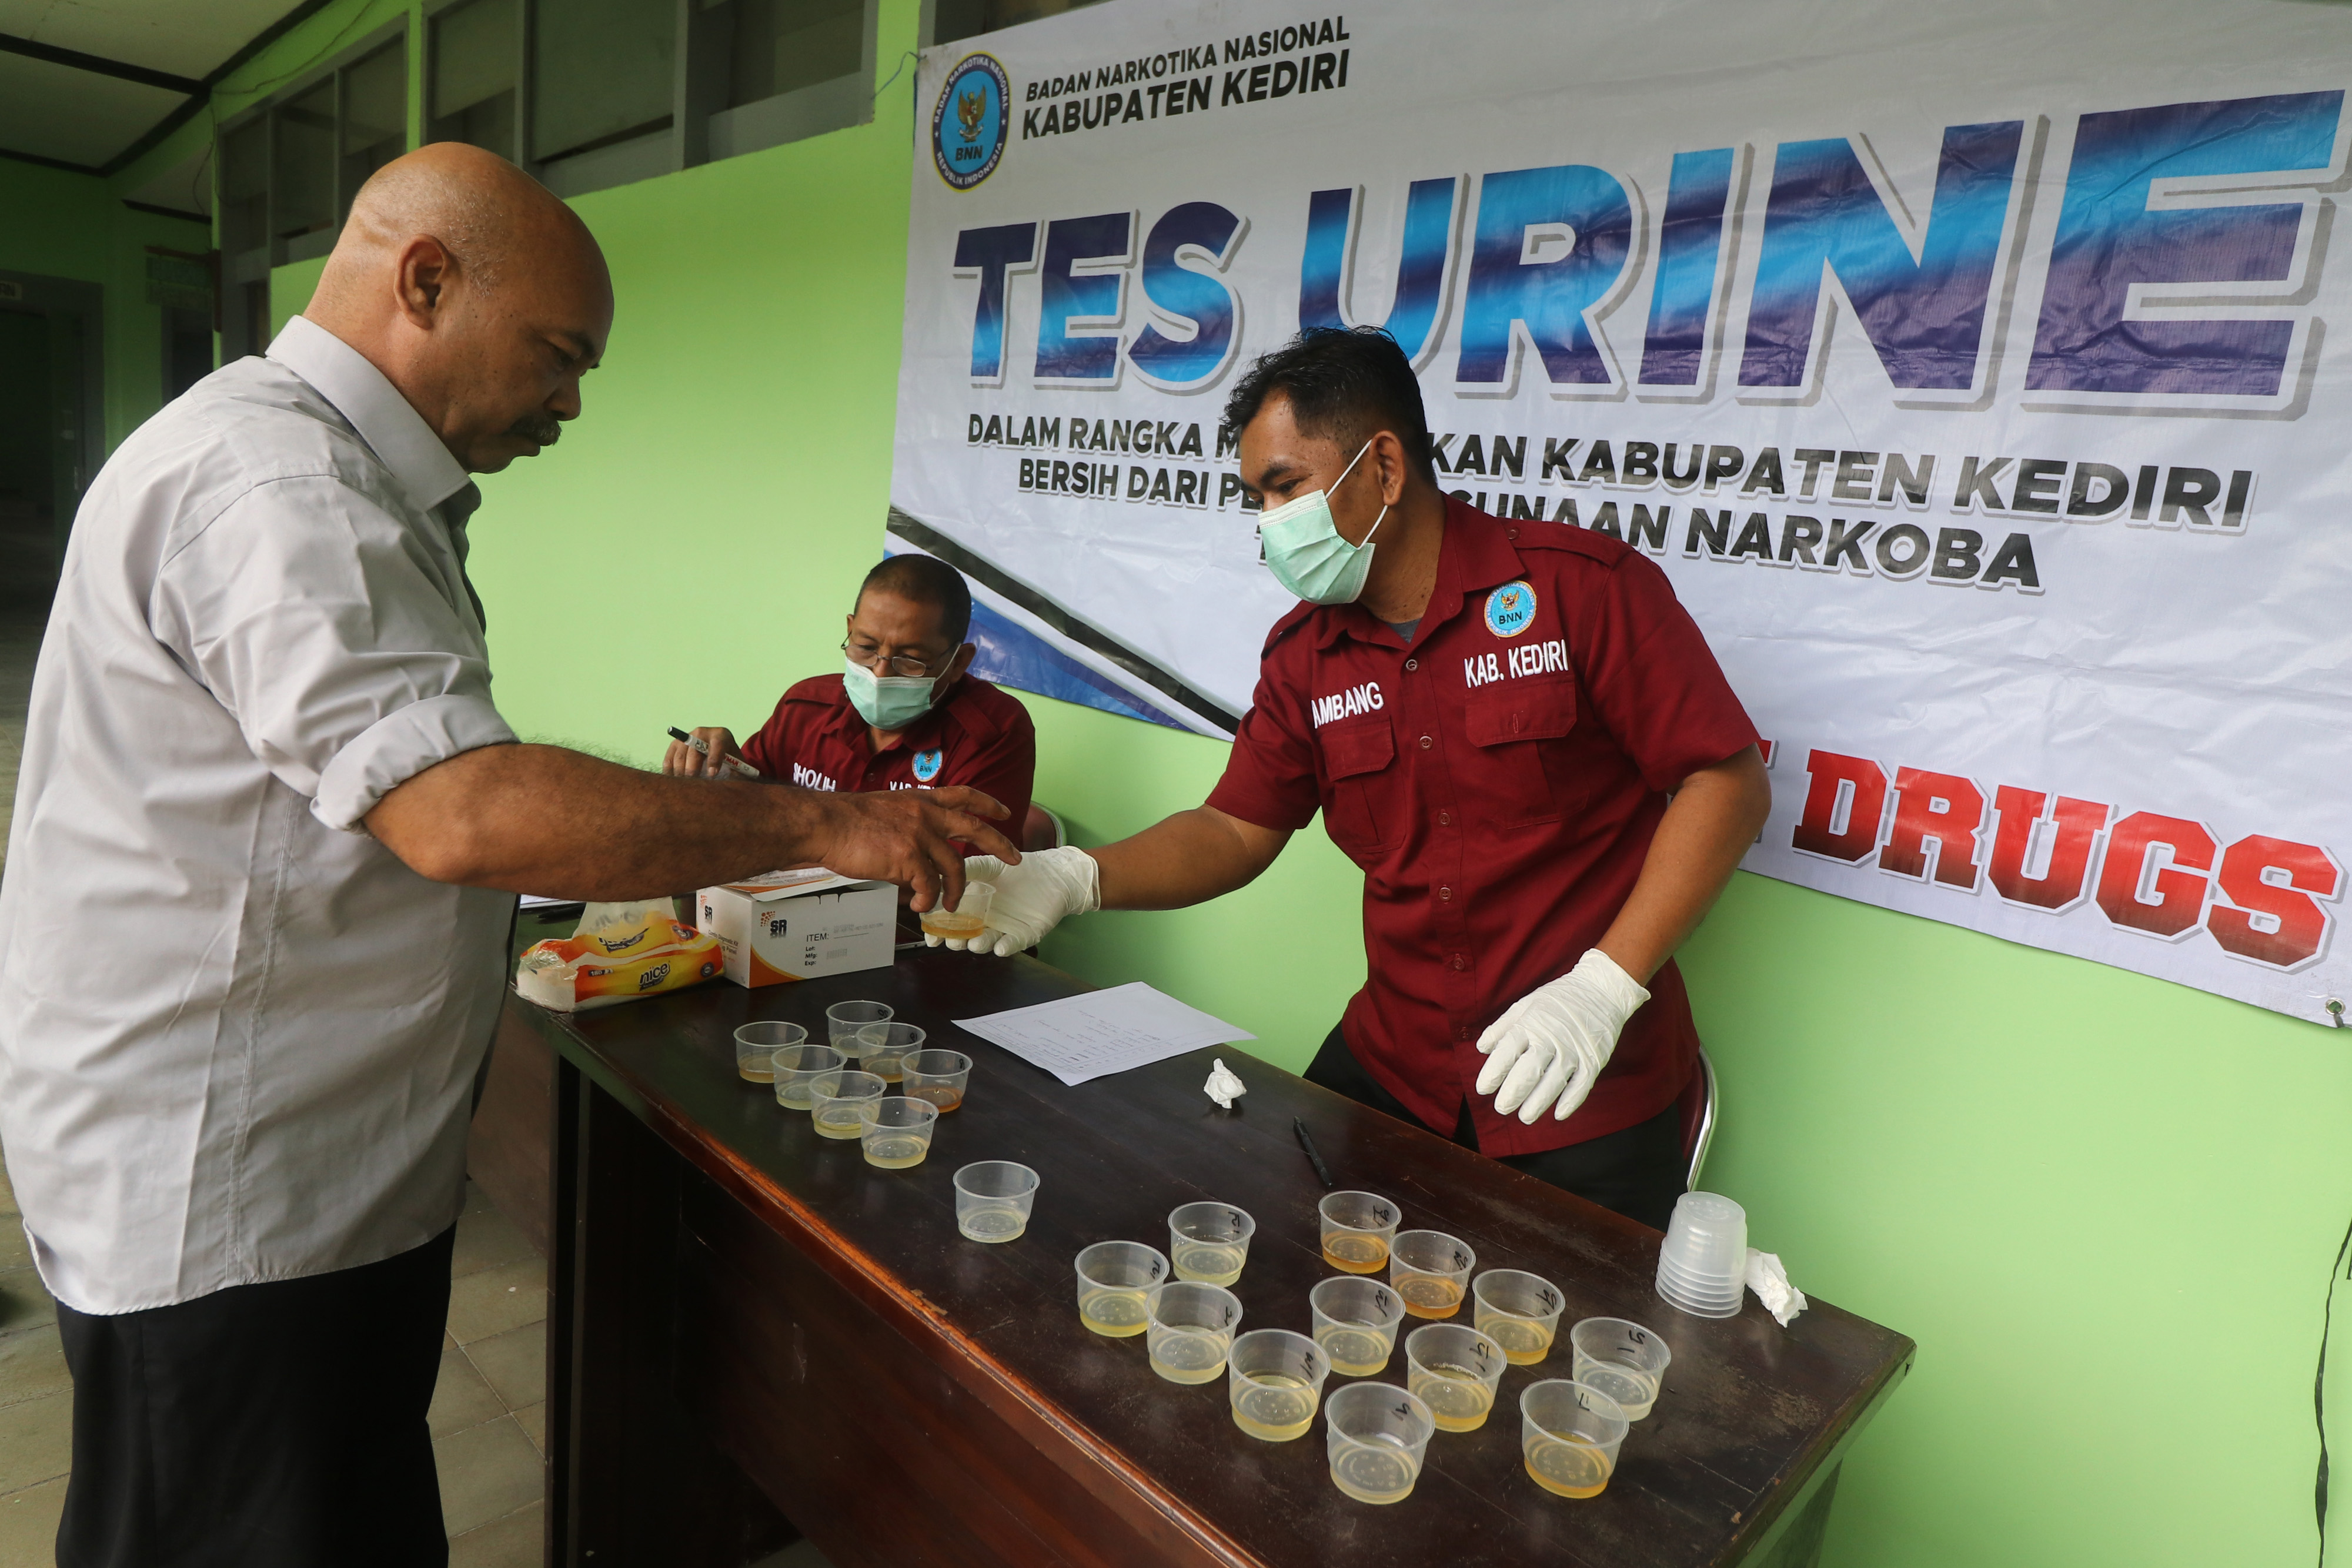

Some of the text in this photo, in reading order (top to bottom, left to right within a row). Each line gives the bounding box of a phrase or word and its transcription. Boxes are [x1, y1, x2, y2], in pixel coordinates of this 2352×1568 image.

[1026, 16, 1350, 102] BADAN NARKOTIKA NASIONAL
[934, 57, 1009, 123] BADAN NARKOTIKA NASIONAL
[1023, 49, 1350, 140] KABUPATEN KEDIRI
[937, 142, 1003, 185] REPUBLIK INDONESIA
[955, 145, 983, 162] BNN
[953, 89, 2346, 397] TES URINE
[968, 414, 1061, 448] DALAM
[1068, 419, 1203, 457] RANGKA
[1541, 437, 1936, 504] KABUPATEN
[1953, 456, 2253, 528] KEDIRI
[1020, 458, 1117, 496] BERSIH
[1127, 466, 1210, 506] DARI
[1685, 507, 2040, 587] NARKOBA
[1499, 611, 1522, 625] BNN
[1464, 638, 1569, 688] KAB. KEDIRI
[1792, 748, 2337, 967] DRUGS
[770, 920, 787, 935] SR
[806, 932, 830, 942] ITEM:
[639, 962, 670, 985] nice
